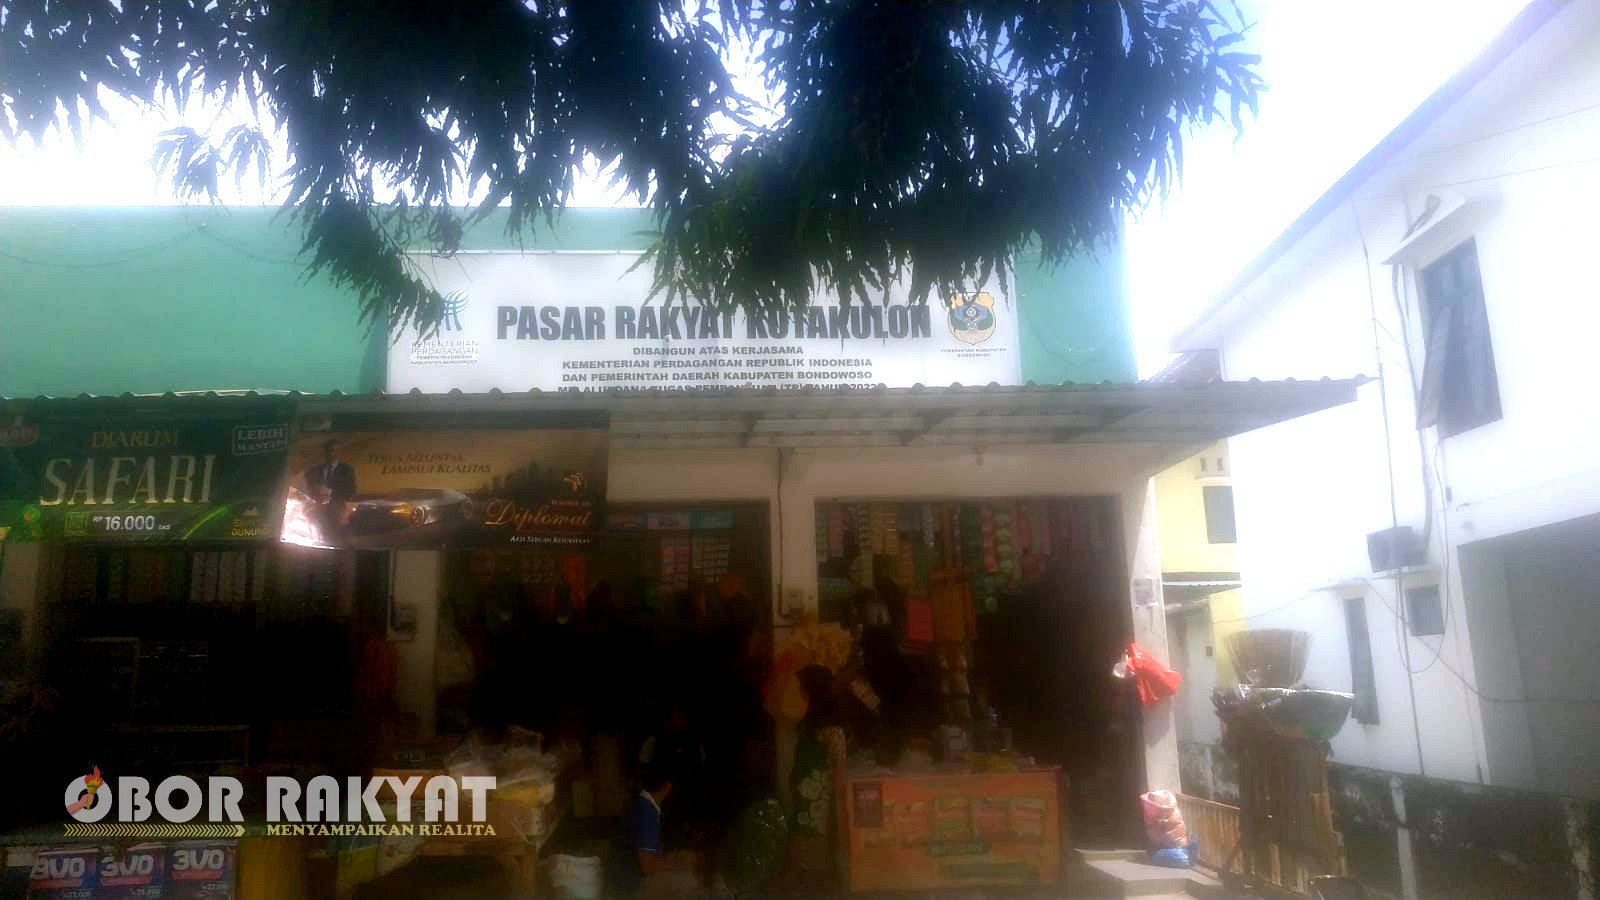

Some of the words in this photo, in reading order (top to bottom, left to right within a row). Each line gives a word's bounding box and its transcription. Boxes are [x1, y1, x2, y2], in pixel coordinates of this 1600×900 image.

[497, 306, 605, 340] PASAR
[615, 305, 732, 339] RAKYAT
[633, 347, 696, 356] DIBANGUN
[700, 346, 729, 356] ATAS
[732, 346, 804, 355] KERJASAMA
[562, 360, 650, 369] KEMENTERIAN
[653, 358, 742, 368] PERDAGANGAN
[746, 358, 804, 367] REPUBLIK
[809, 358, 873, 367] INDONESIA
[562, 373, 587, 382] DAN
[591, 372, 668, 381] PEMERINTAH
[672, 371, 720, 381] DAERAH
[723, 371, 794, 380] KABUPATEN
[797, 371, 872, 379] BONDOWOSO
[40, 455, 216, 506] SAFARI
[105, 515, 155, 530] 16.000
[484, 497, 592, 535] Diplomat
